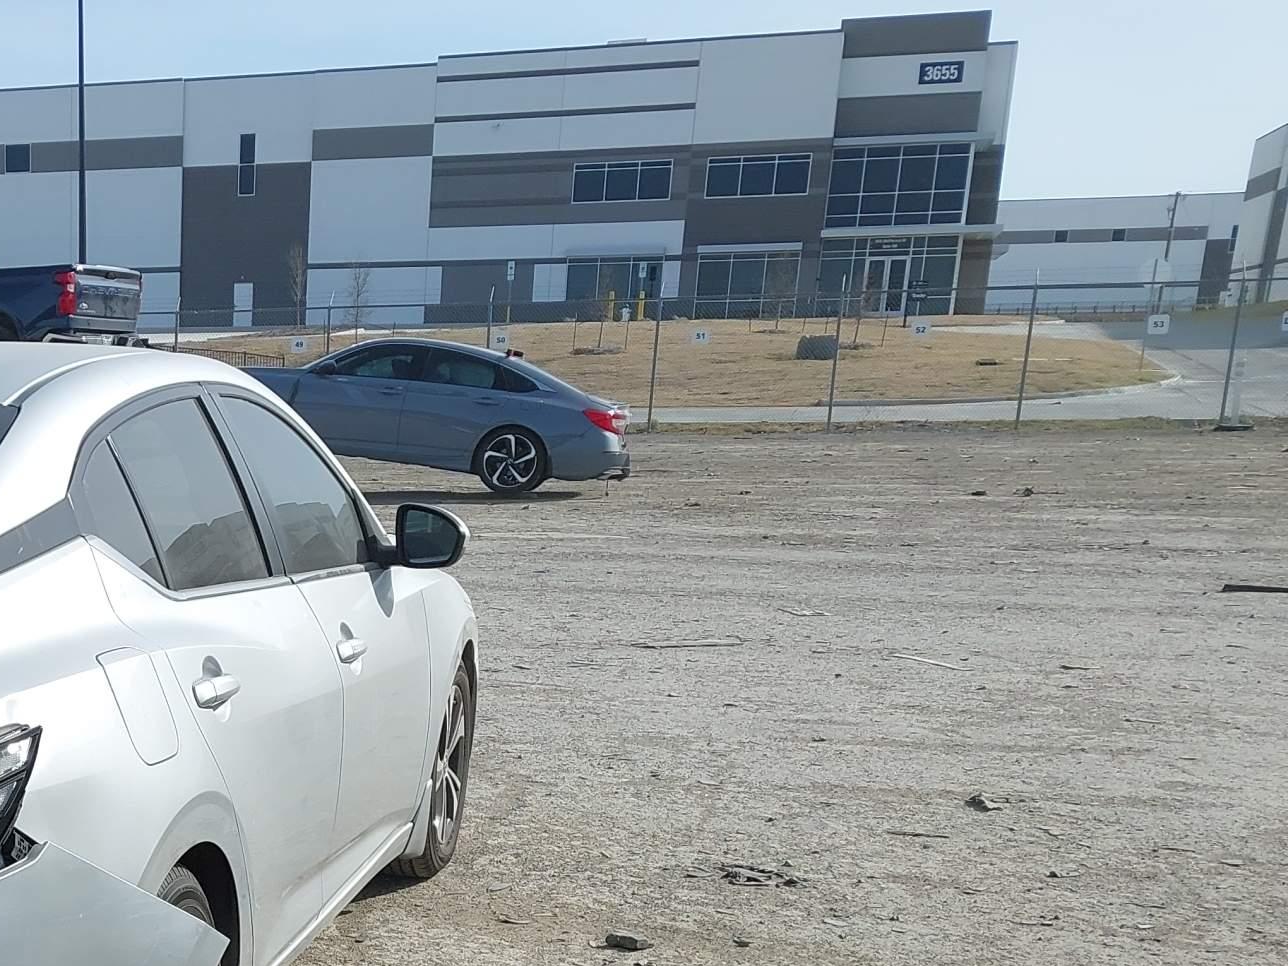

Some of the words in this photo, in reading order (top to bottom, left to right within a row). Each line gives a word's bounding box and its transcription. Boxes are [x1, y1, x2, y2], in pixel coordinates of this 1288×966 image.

[923, 64, 959, 81] 3655
[1152, 320, 1165, 329] 53
[915, 326, 926, 334] 52
[496, 336, 506, 344] 50
[695, 332, 706, 340] 51
